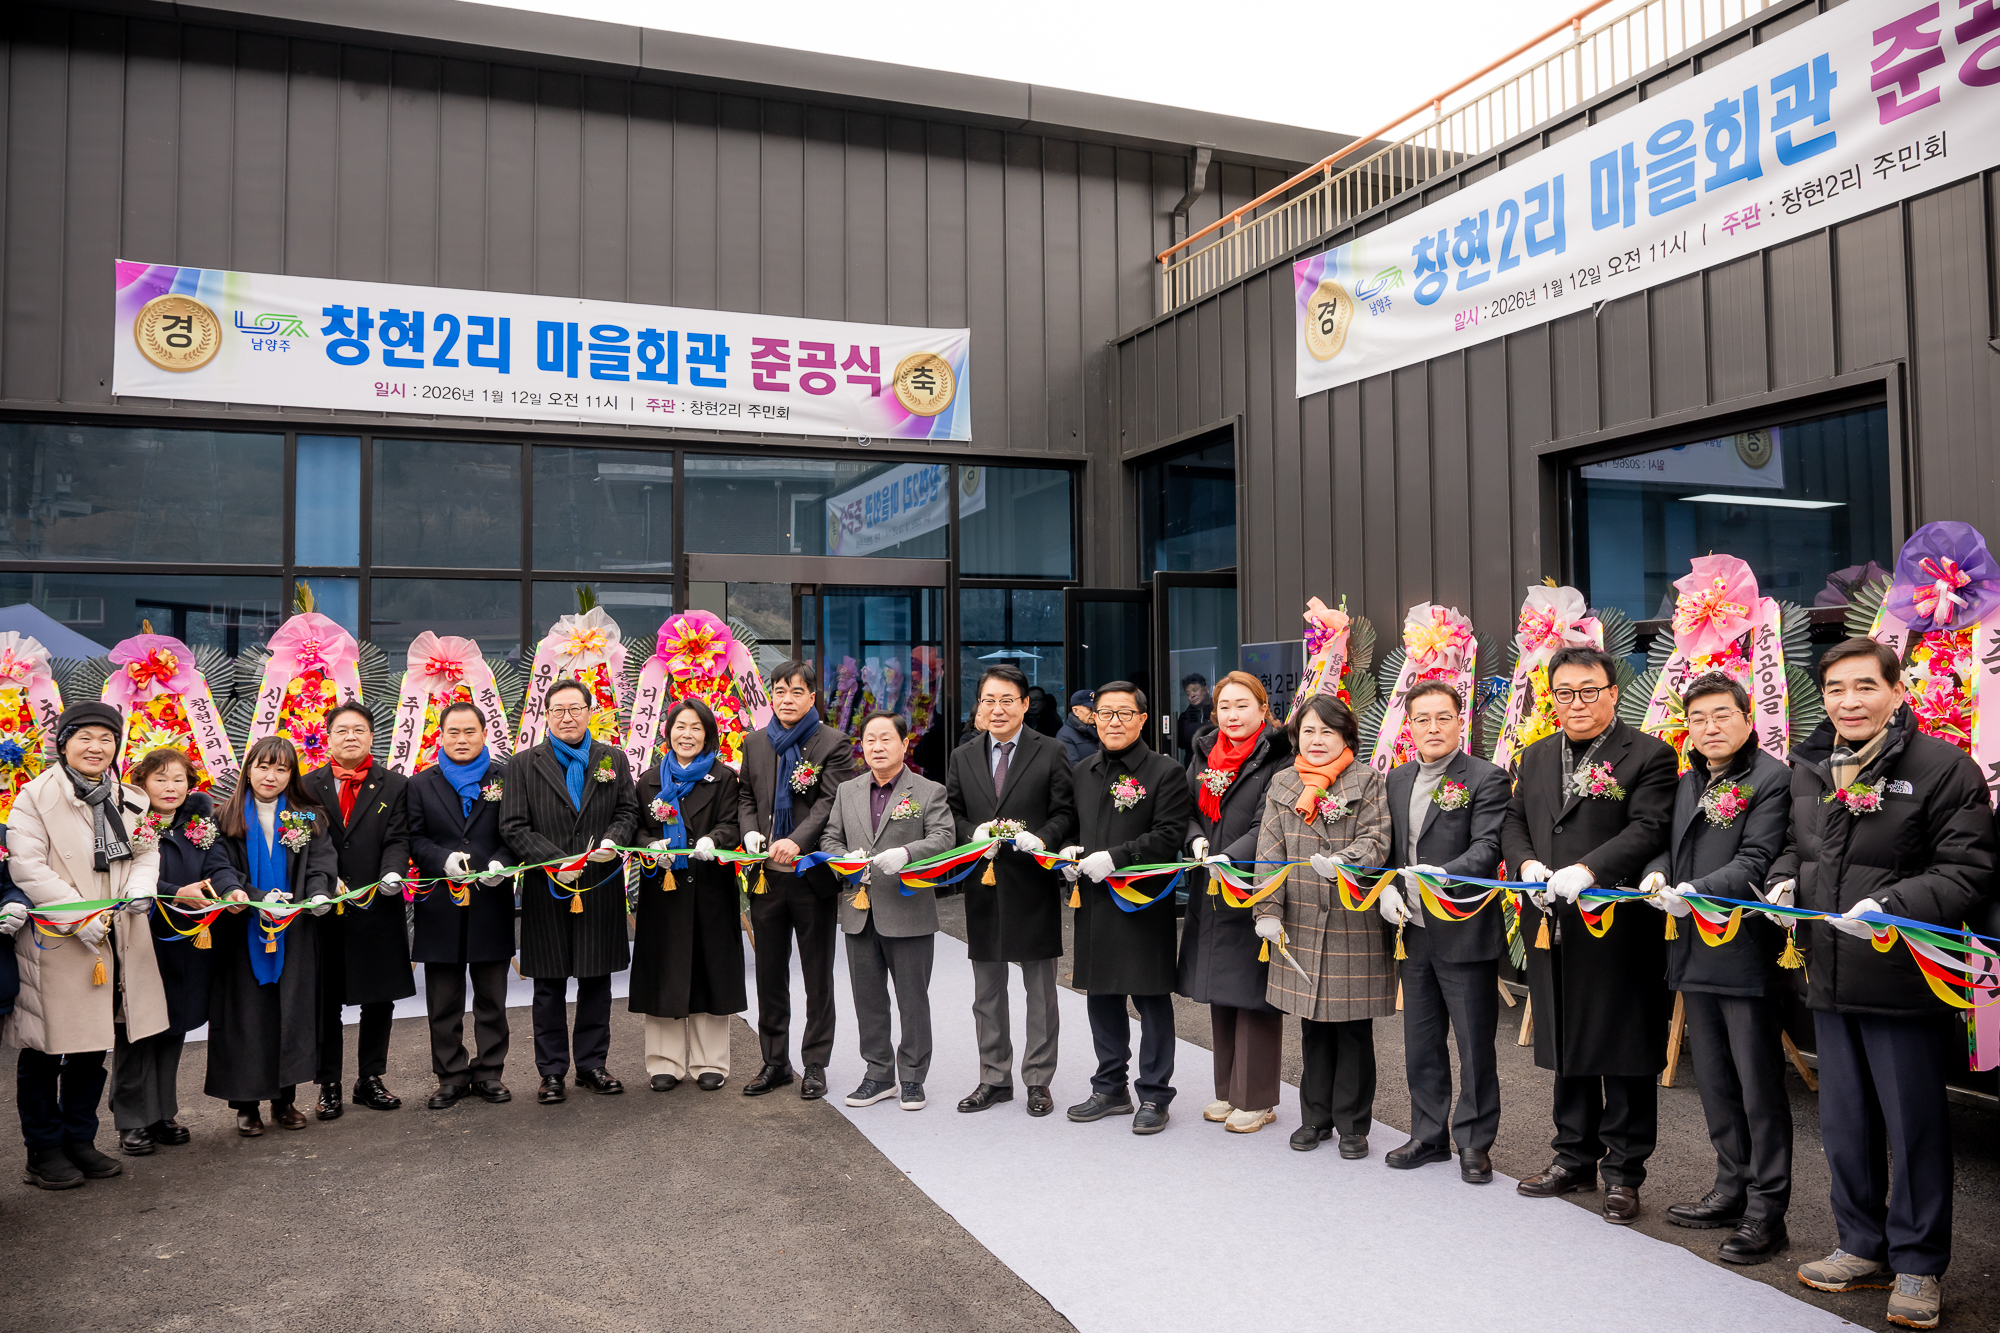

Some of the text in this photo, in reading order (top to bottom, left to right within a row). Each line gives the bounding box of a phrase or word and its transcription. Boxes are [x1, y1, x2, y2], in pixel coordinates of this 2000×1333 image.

[1411, 174, 1567, 306] 창현2리
[1590, 52, 1838, 231] 마을회관
[1454, 306, 1478, 331] 일시
[1491, 288, 1536, 318] 2026년
[1542, 278, 1563, 299] 1월
[1569, 265, 1601, 290] 12일
[1608, 248, 1641, 277] 오전
[1649, 231, 1686, 262] 11시
[1721, 202, 1761, 236] 주관
[1781, 163, 1861, 215] 창현2리
[1872, 131, 1946, 180] 주민회
[1317, 297, 1337, 336] 경
[1369, 295, 1392, 317] 남양주
[162, 314, 193, 348] 경
[250, 337, 291, 352] 남양주
[320, 304, 881, 397] 창현2리 마을회관 준공식
[374, 381, 406, 398] 일시
[422, 385, 474, 402] 2026년
[482, 389, 503, 404] 1월
[511, 391, 541, 406] 12일
[547, 392, 578, 408] 오전
[586, 395, 618, 410] 11시
[646, 398, 675, 413] 주관
[690, 400, 741, 417] 창현2리
[747, 404, 790, 420] 주민회
[910, 366, 937, 395] 축
[1755, 623, 1783, 715] 준공을
[190, 698, 222, 750] 창현2리
[635, 687, 657, 738] 디자인
